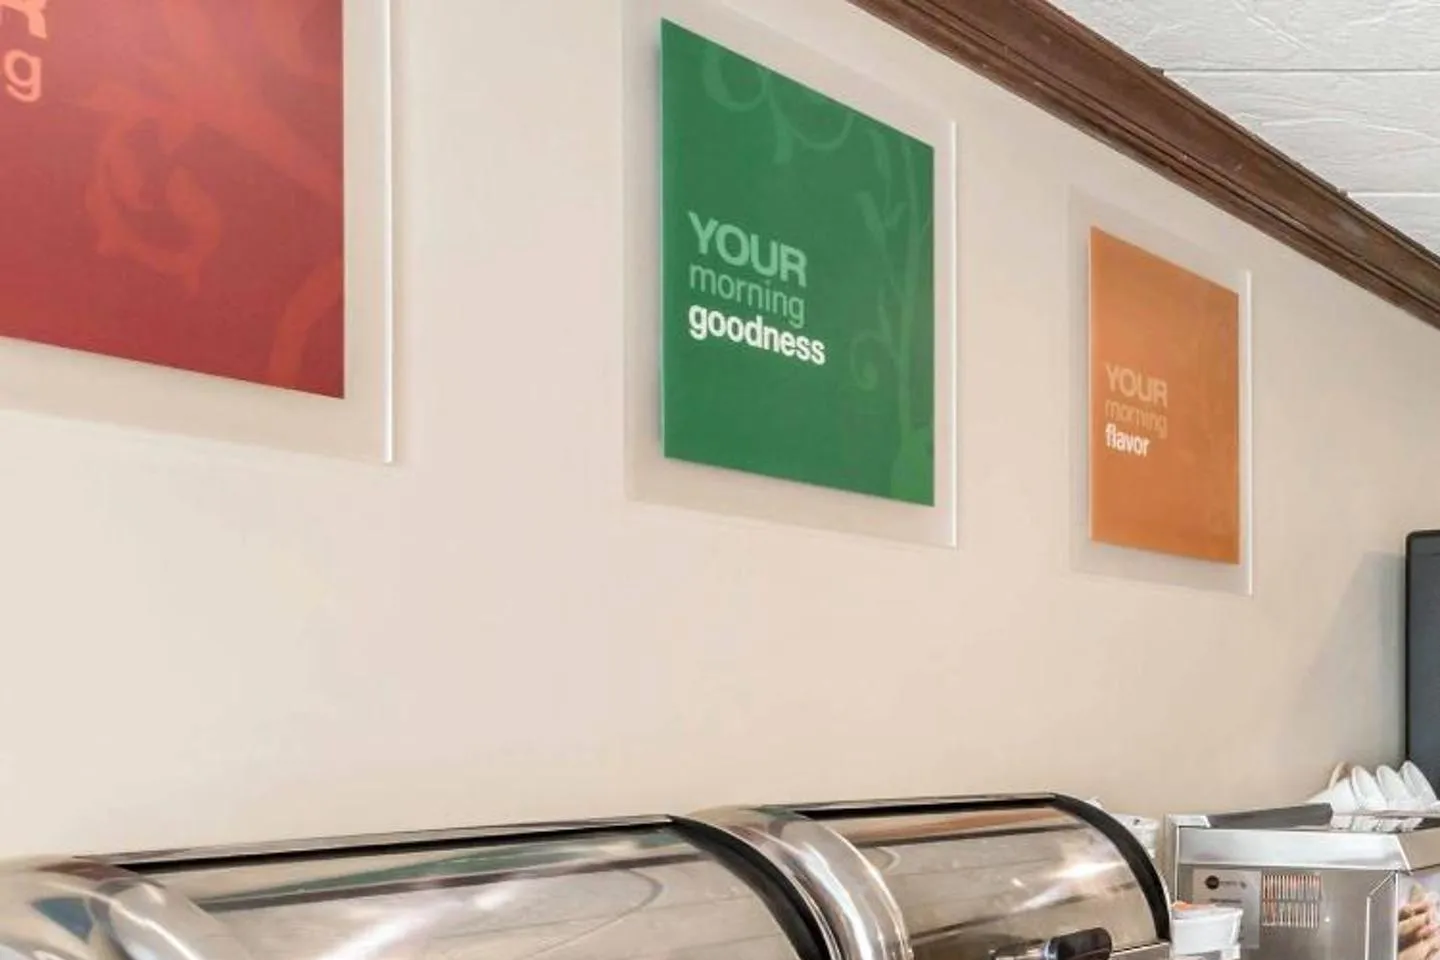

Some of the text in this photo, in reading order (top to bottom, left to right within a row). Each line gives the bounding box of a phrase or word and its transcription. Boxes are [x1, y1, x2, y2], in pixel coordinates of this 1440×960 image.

[687, 210, 808, 288] YOUR
[689, 263, 806, 329] morning
[688, 304, 826, 365] goodness
[1104, 363, 1168, 408] YOUR
[1105, 400, 1168, 439] morning
[1105, 423, 1149, 456] flavor
